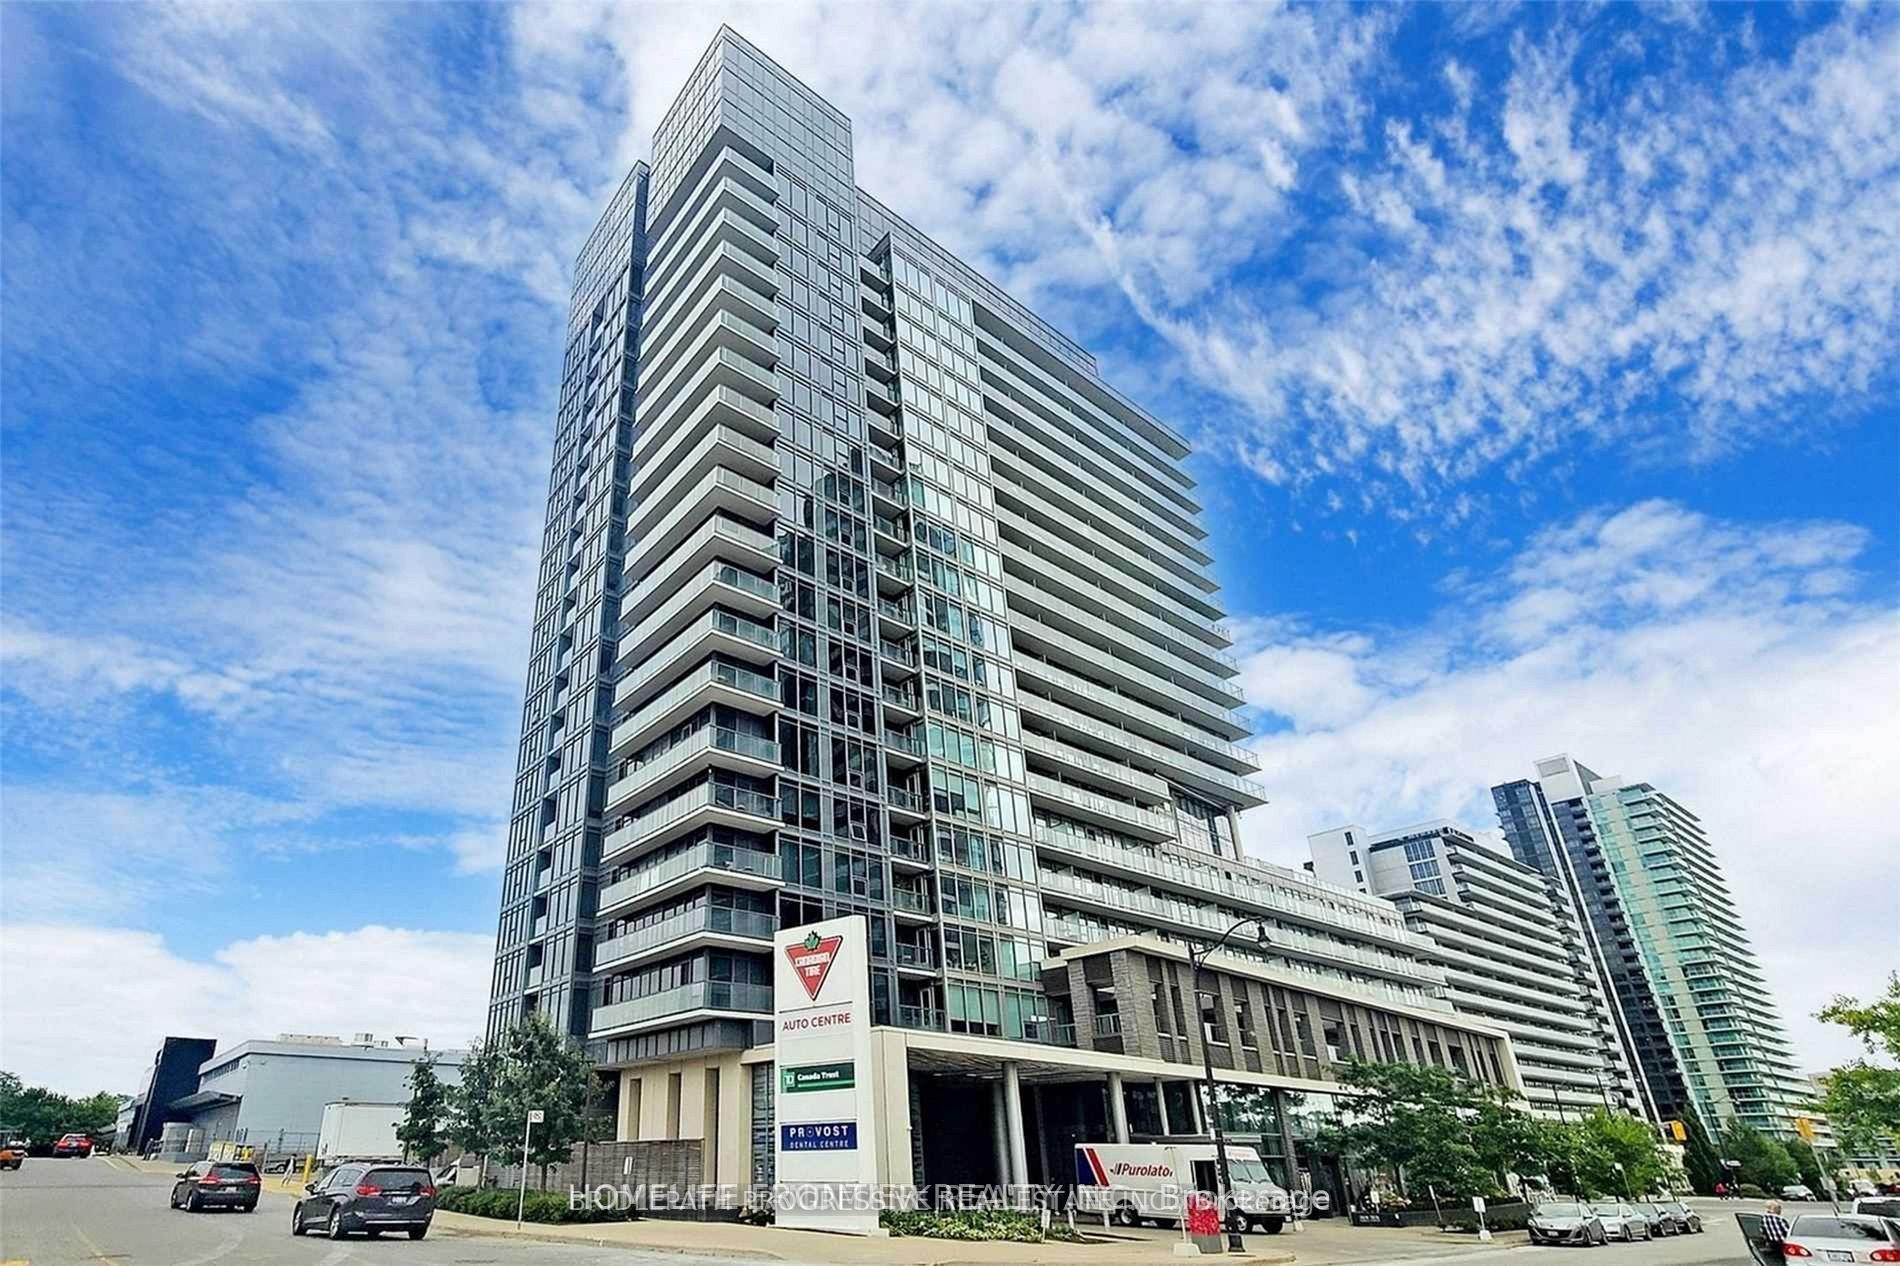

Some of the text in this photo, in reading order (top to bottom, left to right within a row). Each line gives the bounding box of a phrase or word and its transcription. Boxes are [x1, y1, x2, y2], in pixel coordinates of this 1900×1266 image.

[782, 1013, 851, 1031] AUTO CENTRE
[797, 1071, 820, 1081] Canada
[821, 1070, 839, 1079] Trust
[789, 1125, 848, 1138] PROVOST
[789, 1140, 849, 1149] DENTAL CENTRE
